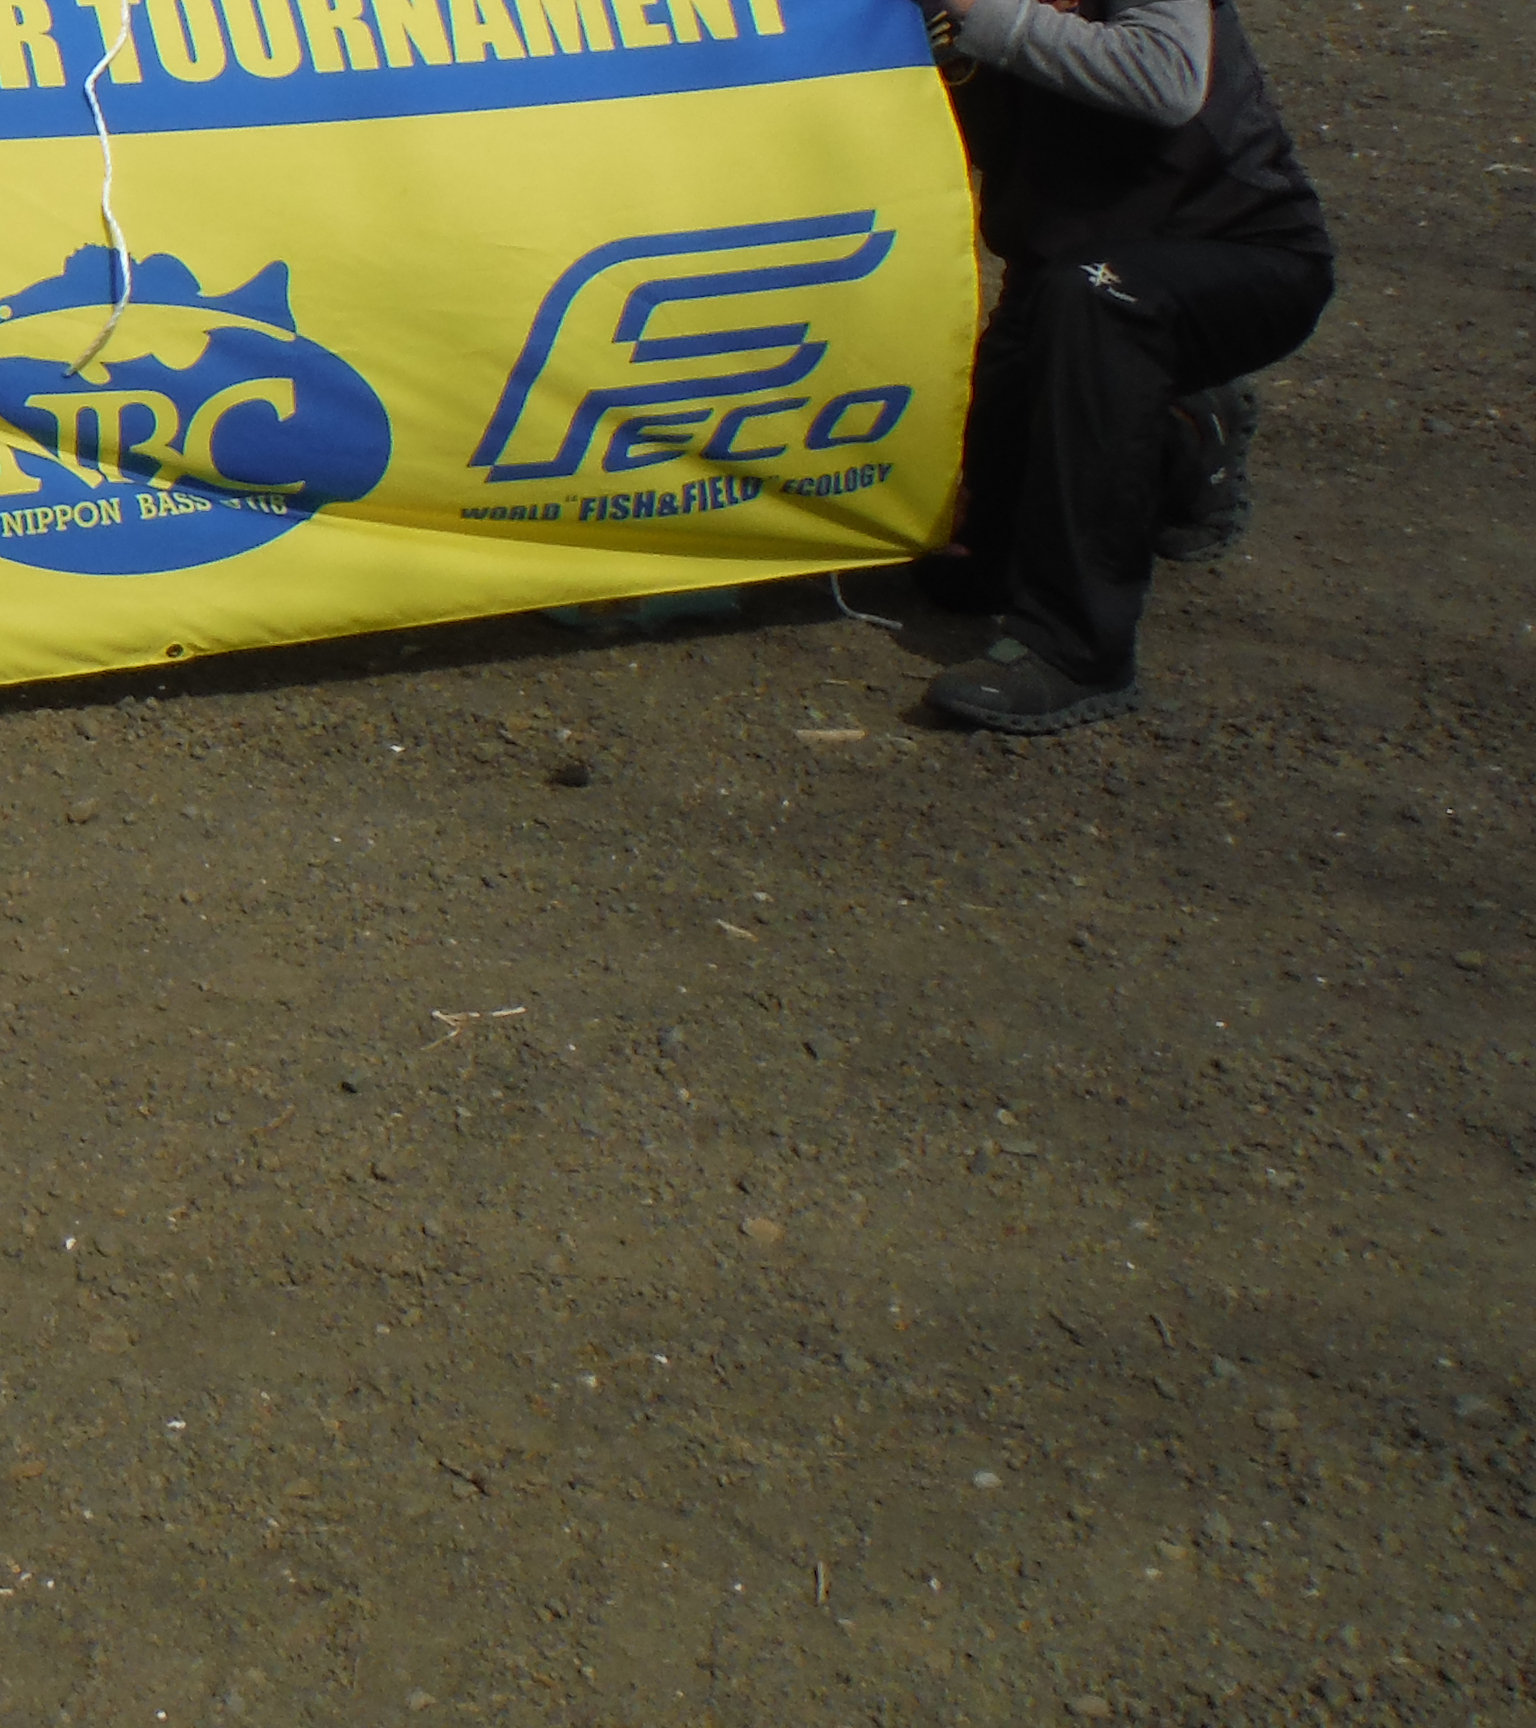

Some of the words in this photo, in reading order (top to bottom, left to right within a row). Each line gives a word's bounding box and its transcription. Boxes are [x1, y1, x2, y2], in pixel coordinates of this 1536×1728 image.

[782, 463, 894, 498] ECOLOGY
[0, 497, 124, 538] NIPPON
[136, 490, 213, 521] BASS
